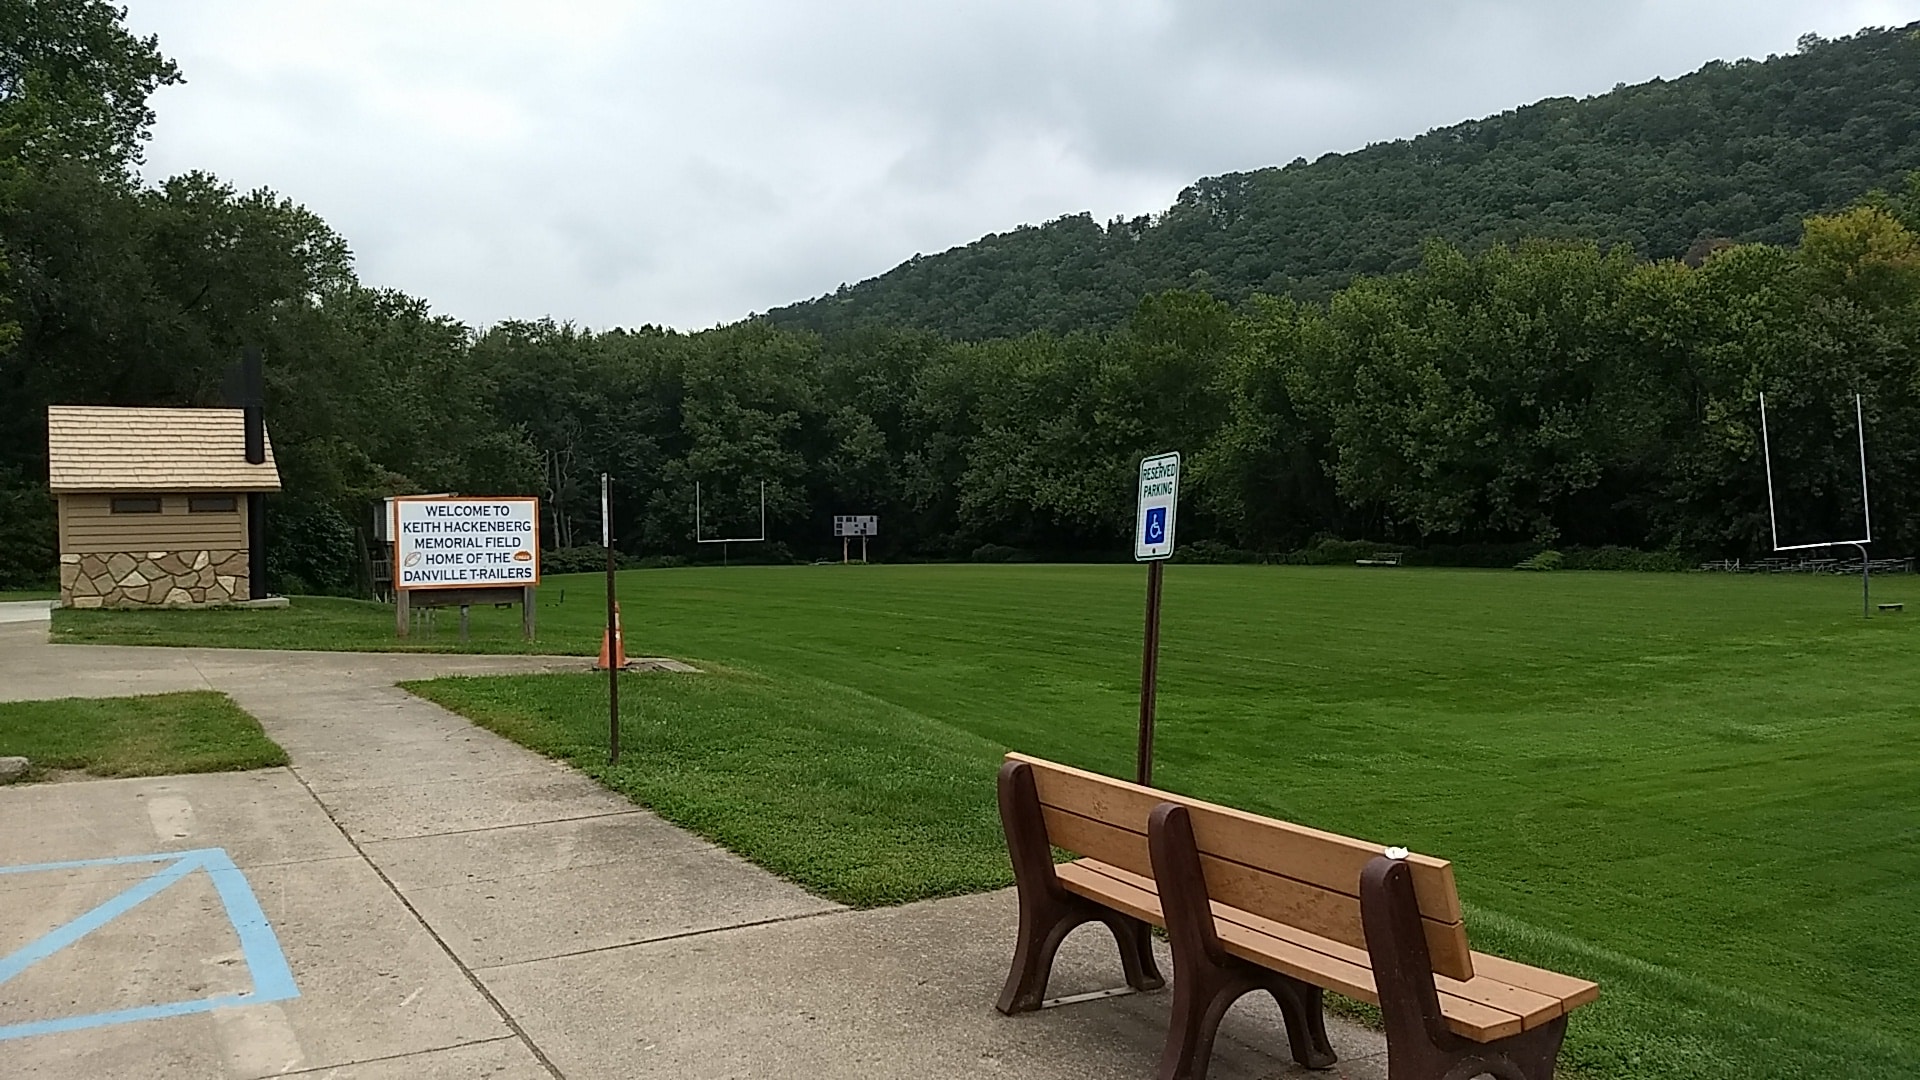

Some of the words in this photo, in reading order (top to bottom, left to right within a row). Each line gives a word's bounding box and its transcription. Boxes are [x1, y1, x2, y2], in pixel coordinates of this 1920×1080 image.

[1143, 464, 1175, 481] RESERVED
[1143, 481, 1173, 498] PARKING
[425, 505, 491, 516] WELCOME
[493, 505, 510, 516] TO
[403, 522, 441, 533] KEITH
[444, 521, 531, 532] HACKENBERG
[415, 538, 483, 549] MEMORIAL
[485, 537, 521, 548] FIELD
[426, 554, 463, 564] HOME
[466, 553, 483, 564] OF
[486, 553, 510, 563] THE
[404, 569, 467, 581] DANVILLE
